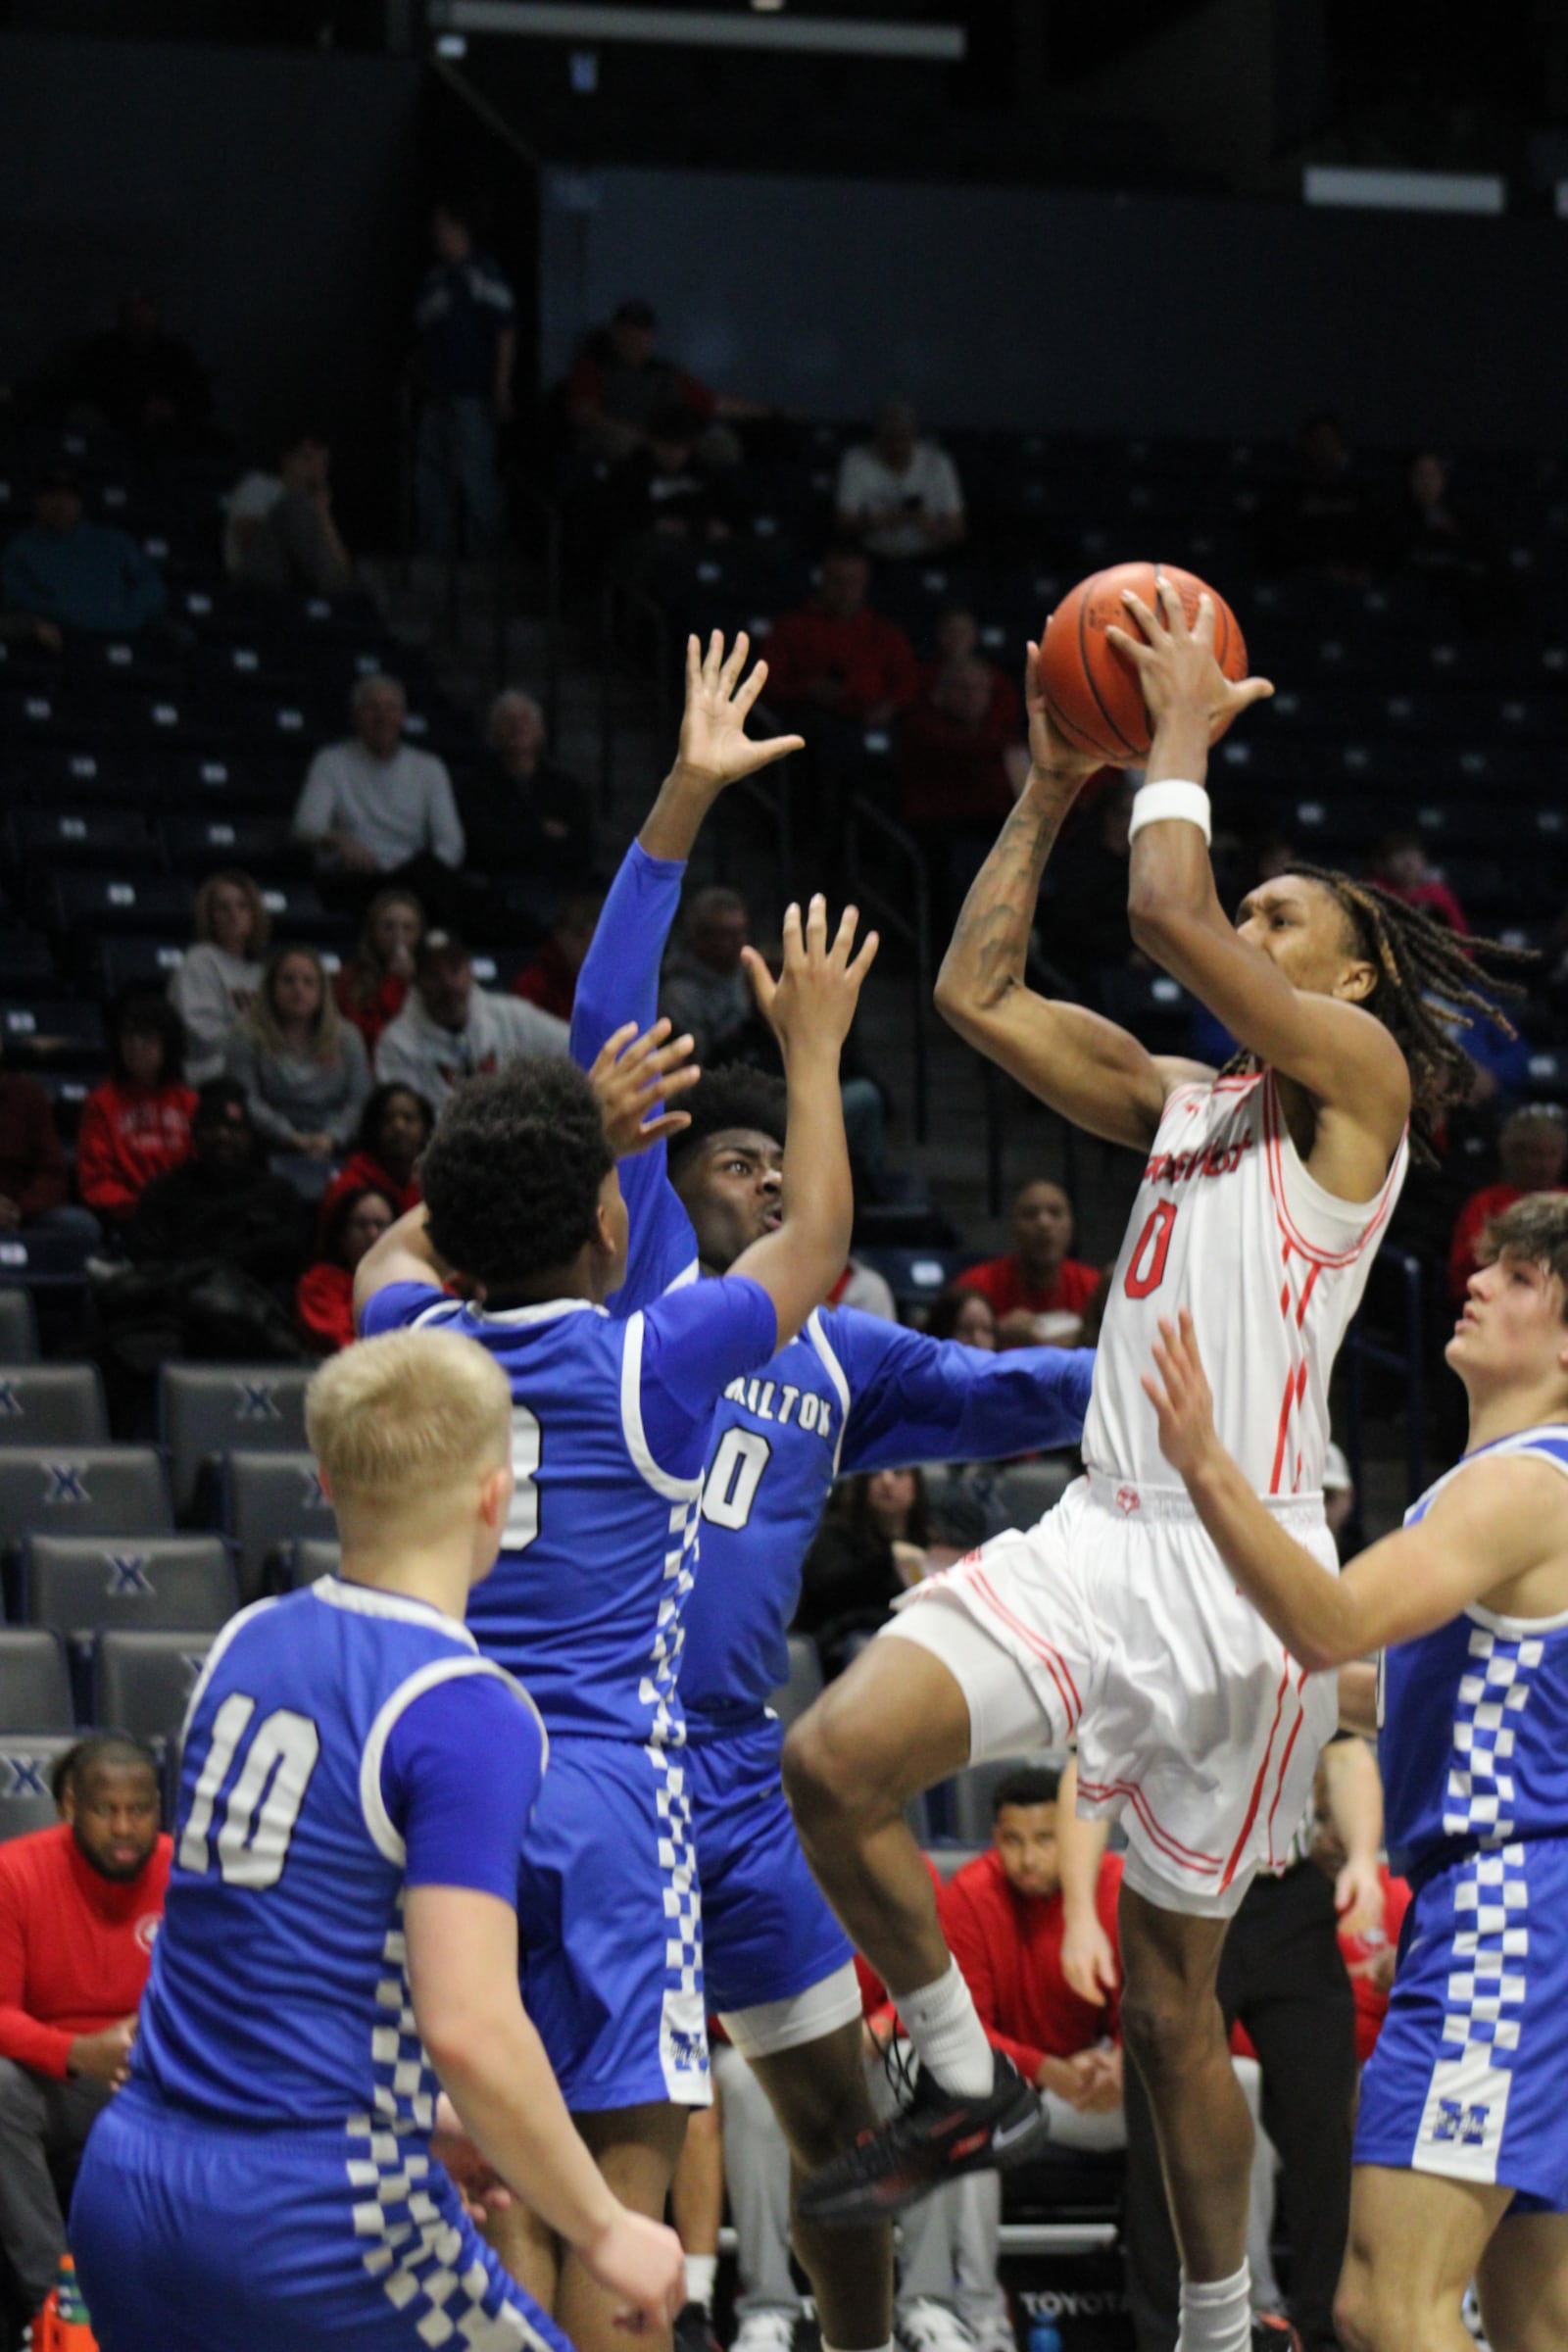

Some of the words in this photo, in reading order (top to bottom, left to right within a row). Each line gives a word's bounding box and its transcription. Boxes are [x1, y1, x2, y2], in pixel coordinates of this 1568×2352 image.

[1124, 1197, 1178, 1298] 0
[702, 1426, 771, 1531] 0
[179, 1691, 319, 1891] 10
